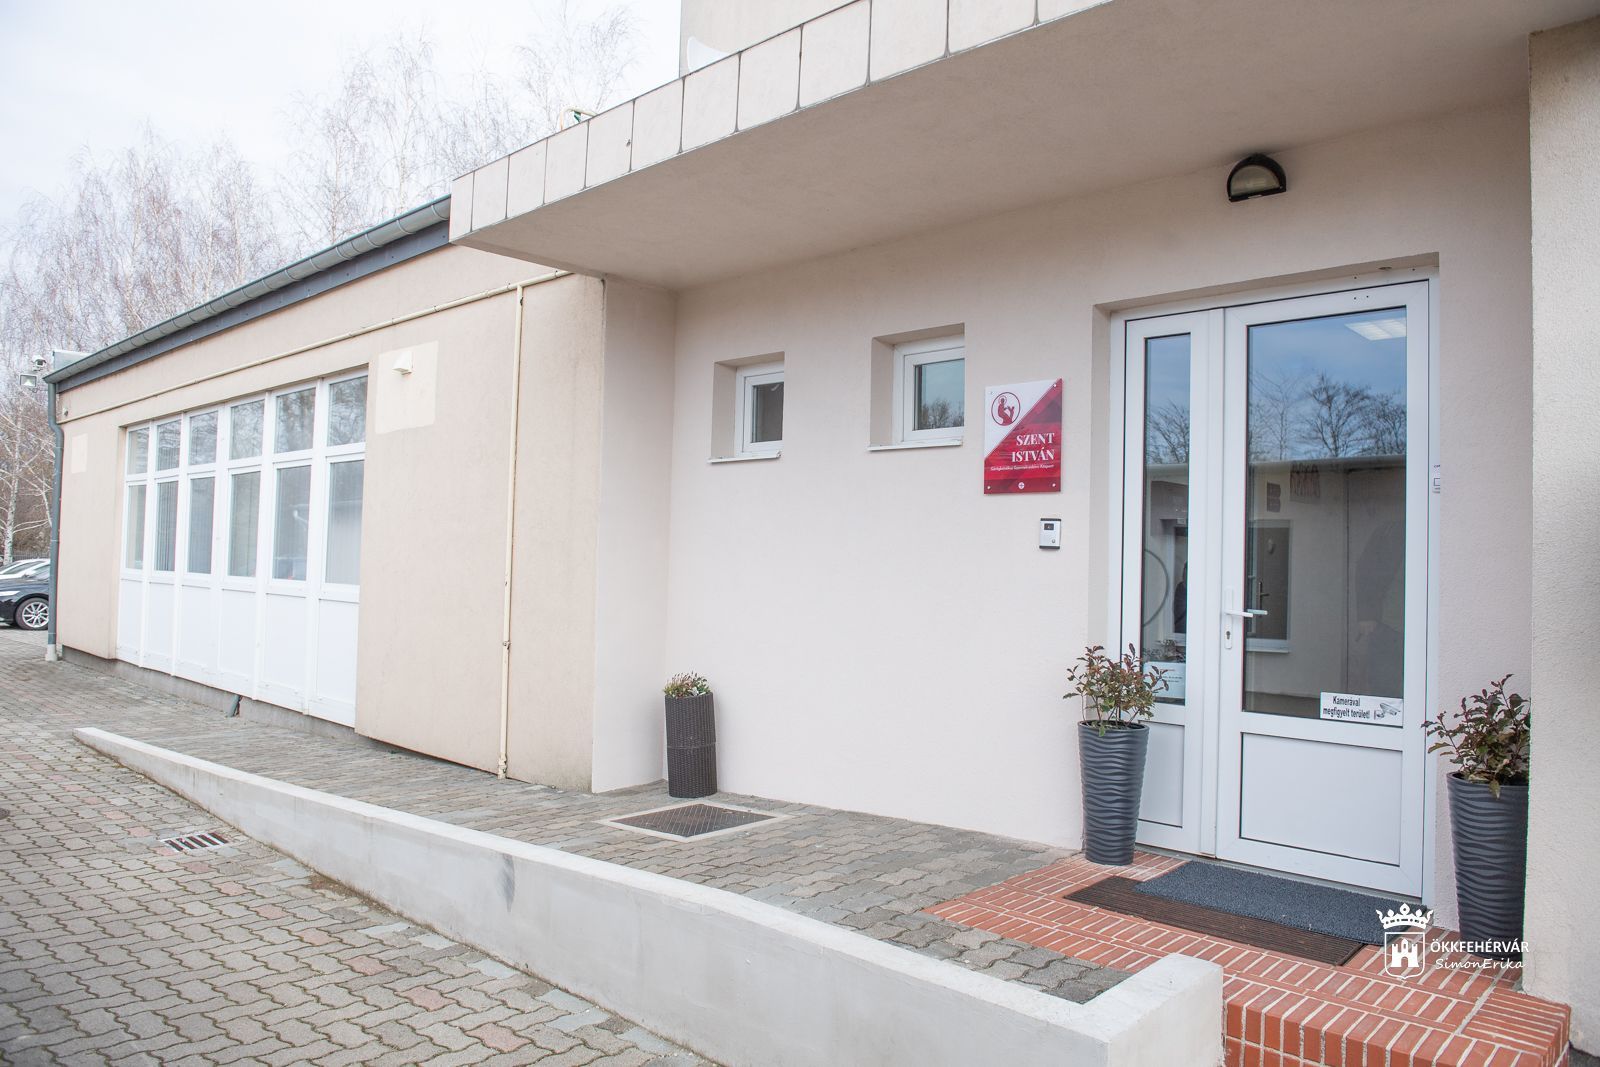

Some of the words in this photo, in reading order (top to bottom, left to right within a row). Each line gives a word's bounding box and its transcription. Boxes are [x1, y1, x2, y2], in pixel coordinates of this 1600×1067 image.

[1016, 432, 1055, 446] SZENT
[1011, 447, 1055, 463] ISTVÁN
[1322, 706, 1350, 719] megfigyelt
